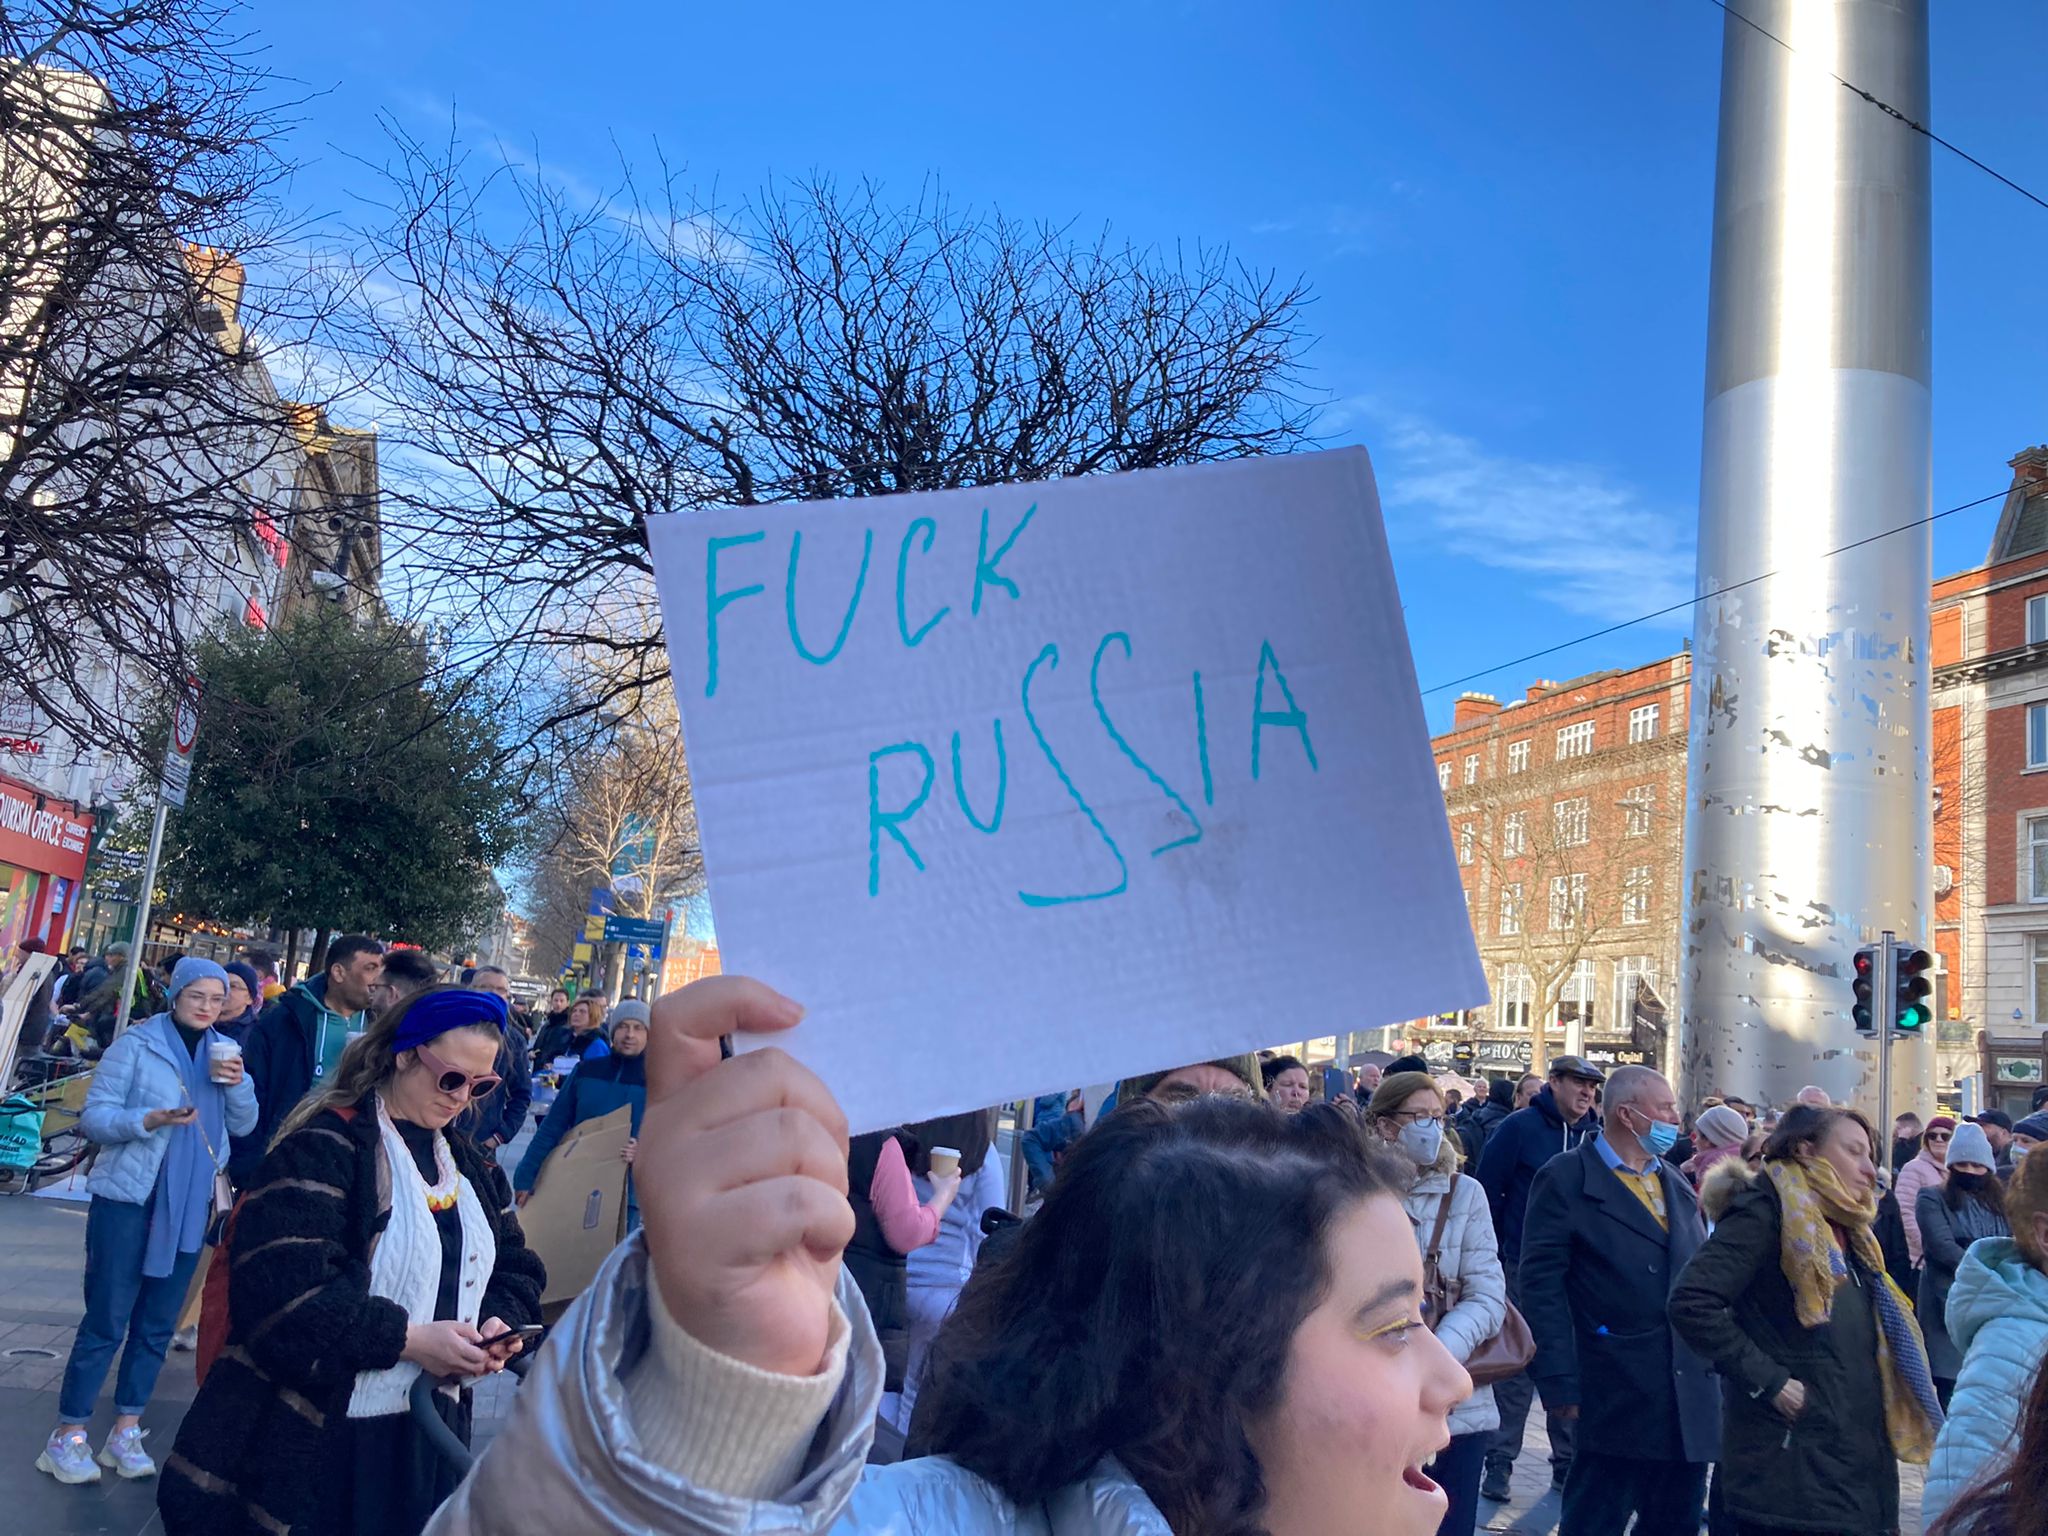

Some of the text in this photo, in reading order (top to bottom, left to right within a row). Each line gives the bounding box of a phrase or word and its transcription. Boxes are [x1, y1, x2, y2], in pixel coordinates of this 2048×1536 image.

[705, 503, 1037, 698] FUCK
[869, 632, 1318, 907] RUSSIA
[31, 810, 64, 848] OFFICE
[1617, 1050, 1644, 1065] Capital
